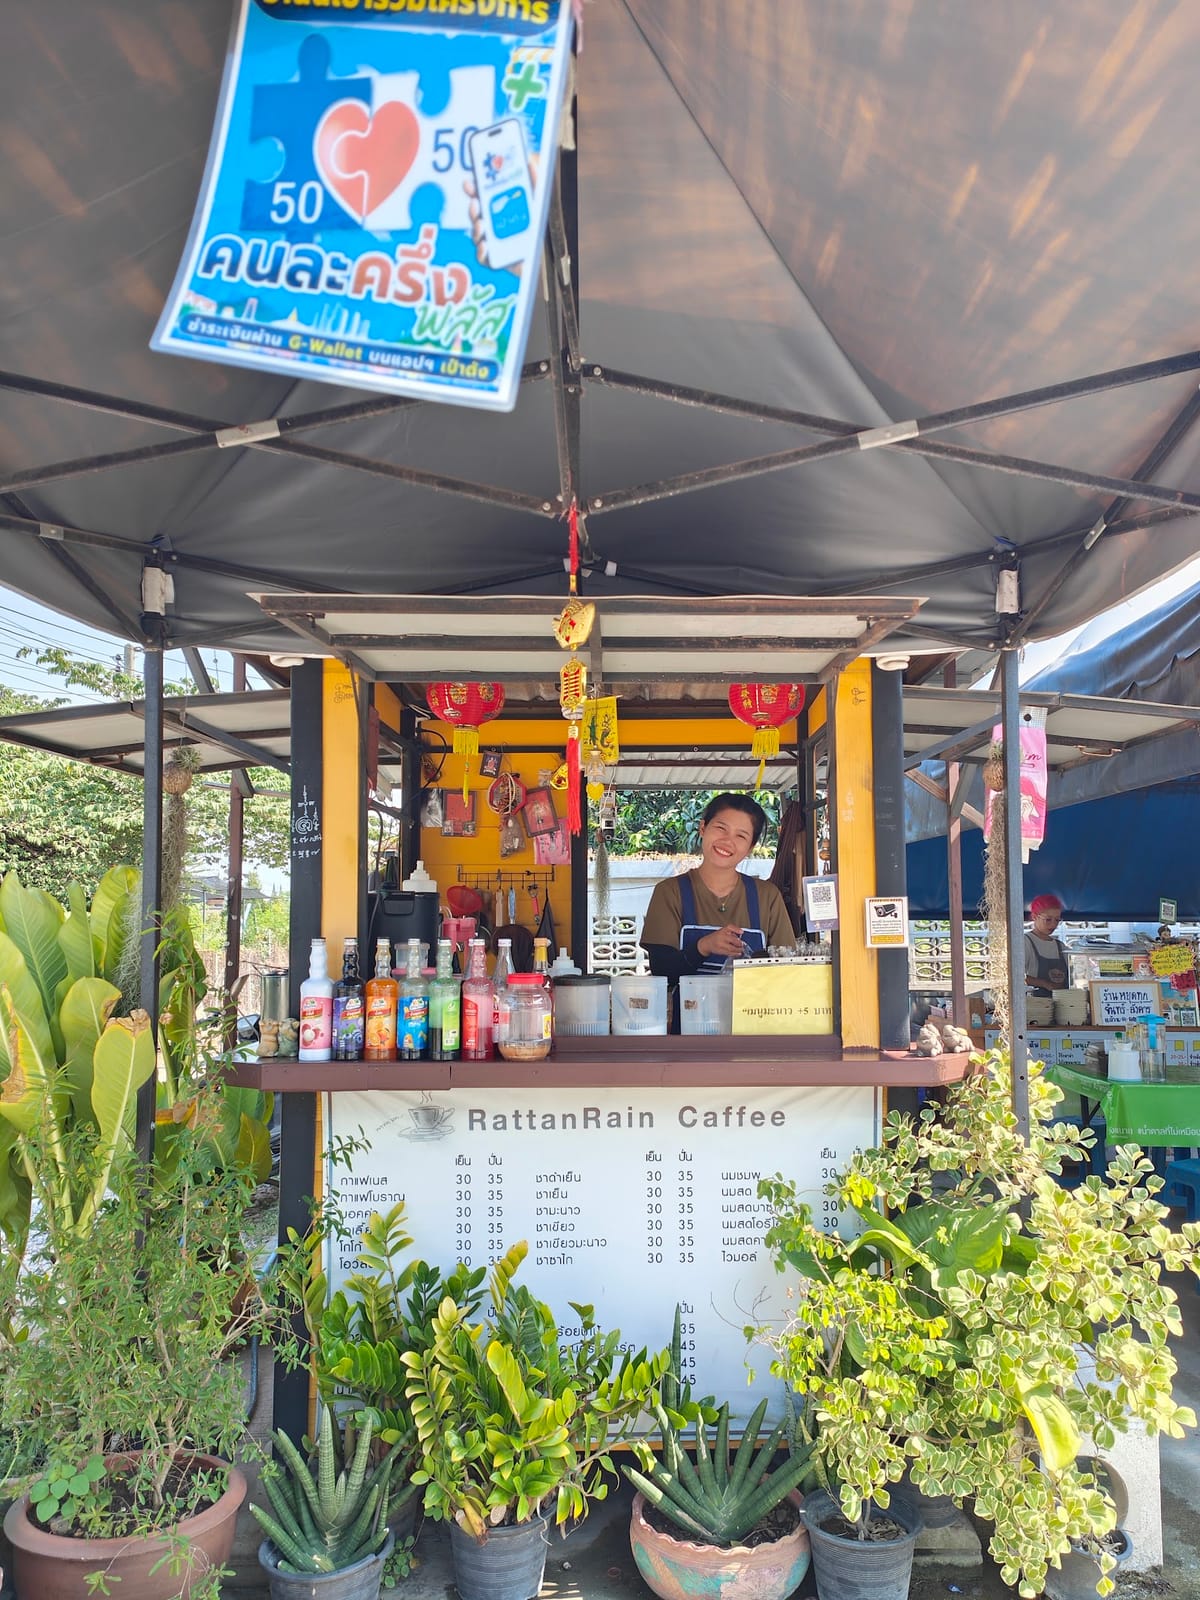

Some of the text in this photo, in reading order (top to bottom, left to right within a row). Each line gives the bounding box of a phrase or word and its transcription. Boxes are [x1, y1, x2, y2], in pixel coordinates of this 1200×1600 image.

[269, 181, 324, 224] 50
[200, 227, 469, 307] คนละครึ่ง
[414, 284, 514, 345] พลัส
[288, 335, 363, 360] G-Wallet
[469, 1103, 787, 1131] RattanRain Caffee
[340, 1174, 503, 1185] กาแฟเนส 30 35
[536, 1171, 694, 1183] ชาดำเย็น 30 35
[721, 1172, 760, 1180] นมชมพ
[456, 1190, 471, 1200] 30
[488, 1190, 503, 1200] 35
[536, 1187, 694, 1199] ชาเย็น 30 35
[721, 1188, 752, 1197] นมสด
[456, 1206, 471, 1216] 30
[488, 1206, 503, 1216] 35
[536, 1203, 694, 1215] ชามะนาว 30 35
[823, 1201, 837, 1211] 30
[536, 1220, 694, 1232] ชาเขียว 30 35
[824, 1217, 838, 1227] 30
[456, 1223, 471, 1233] 30
[488, 1223, 503, 1233] 35
[456, 1240, 471, 1250] 30
[488, 1240, 503, 1250] 35
[536, 1236, 694, 1248] ชาเขียวมะนาว 30 35
[647, 1253, 662, 1263] 30
[678, 1253, 694, 1263] 35
[680, 1324, 695, 1334] 35
[680, 1341, 695, 1351] 45
[680, 1358, 695, 1368] 45
